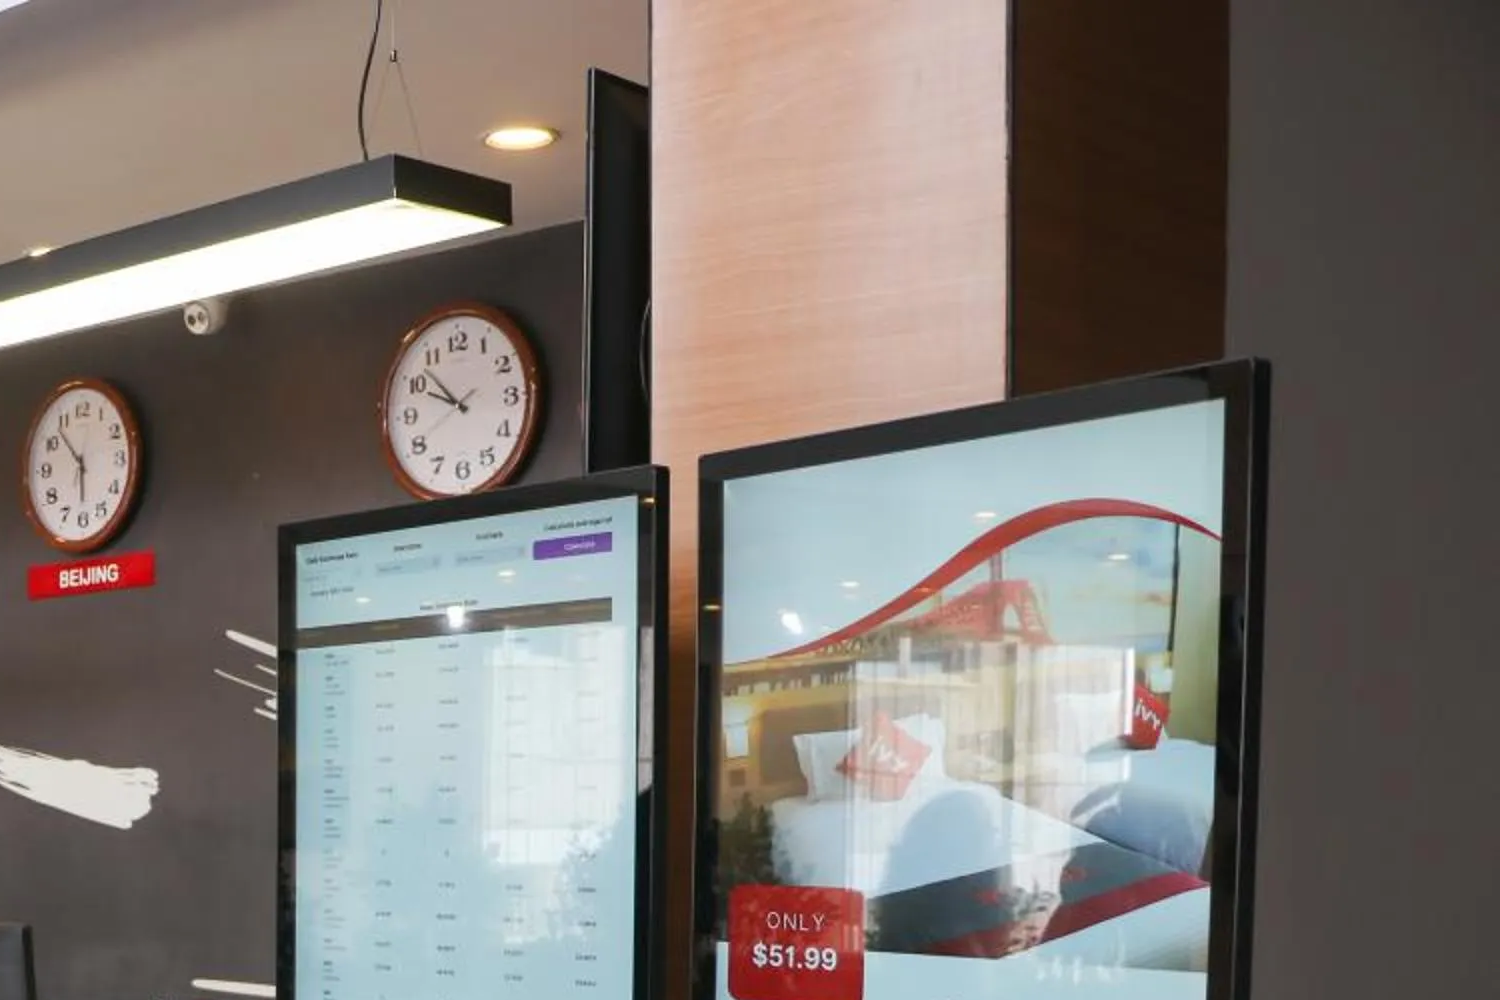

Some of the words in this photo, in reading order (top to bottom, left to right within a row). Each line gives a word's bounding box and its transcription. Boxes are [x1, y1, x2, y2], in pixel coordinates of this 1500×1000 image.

[448, 331, 469, 352] 12
[479, 337, 487, 354] 1
[426, 348, 440, 365] 11
[495, 356, 512, 373] 2
[409, 375, 426, 394] 10
[504, 386, 519, 406] 3
[75, 401, 90, 418] 12
[404, 408, 418, 425] 9
[59, 413, 69, 428] 11
[497, 420, 511, 438] 4
[109, 424, 120, 439] 2
[47, 436, 58, 450] 10
[411, 436, 427, 454] 8
[115, 450, 125, 465] 3
[480, 446, 495, 466] 5
[41, 463, 52, 478] 9
[430, 456, 444, 474] 7
[455, 461, 470, 479] 6
[108, 479, 119, 494] 4
[46, 487, 58, 504] 8
[60, 508, 70, 522] 7
[95, 502, 107, 517] 5
[77, 511, 89, 528] 6
[58, 564, 120, 589] BEIJING
[767, 912, 825, 931] ONLY
[752, 940, 837, 971] $51.99
